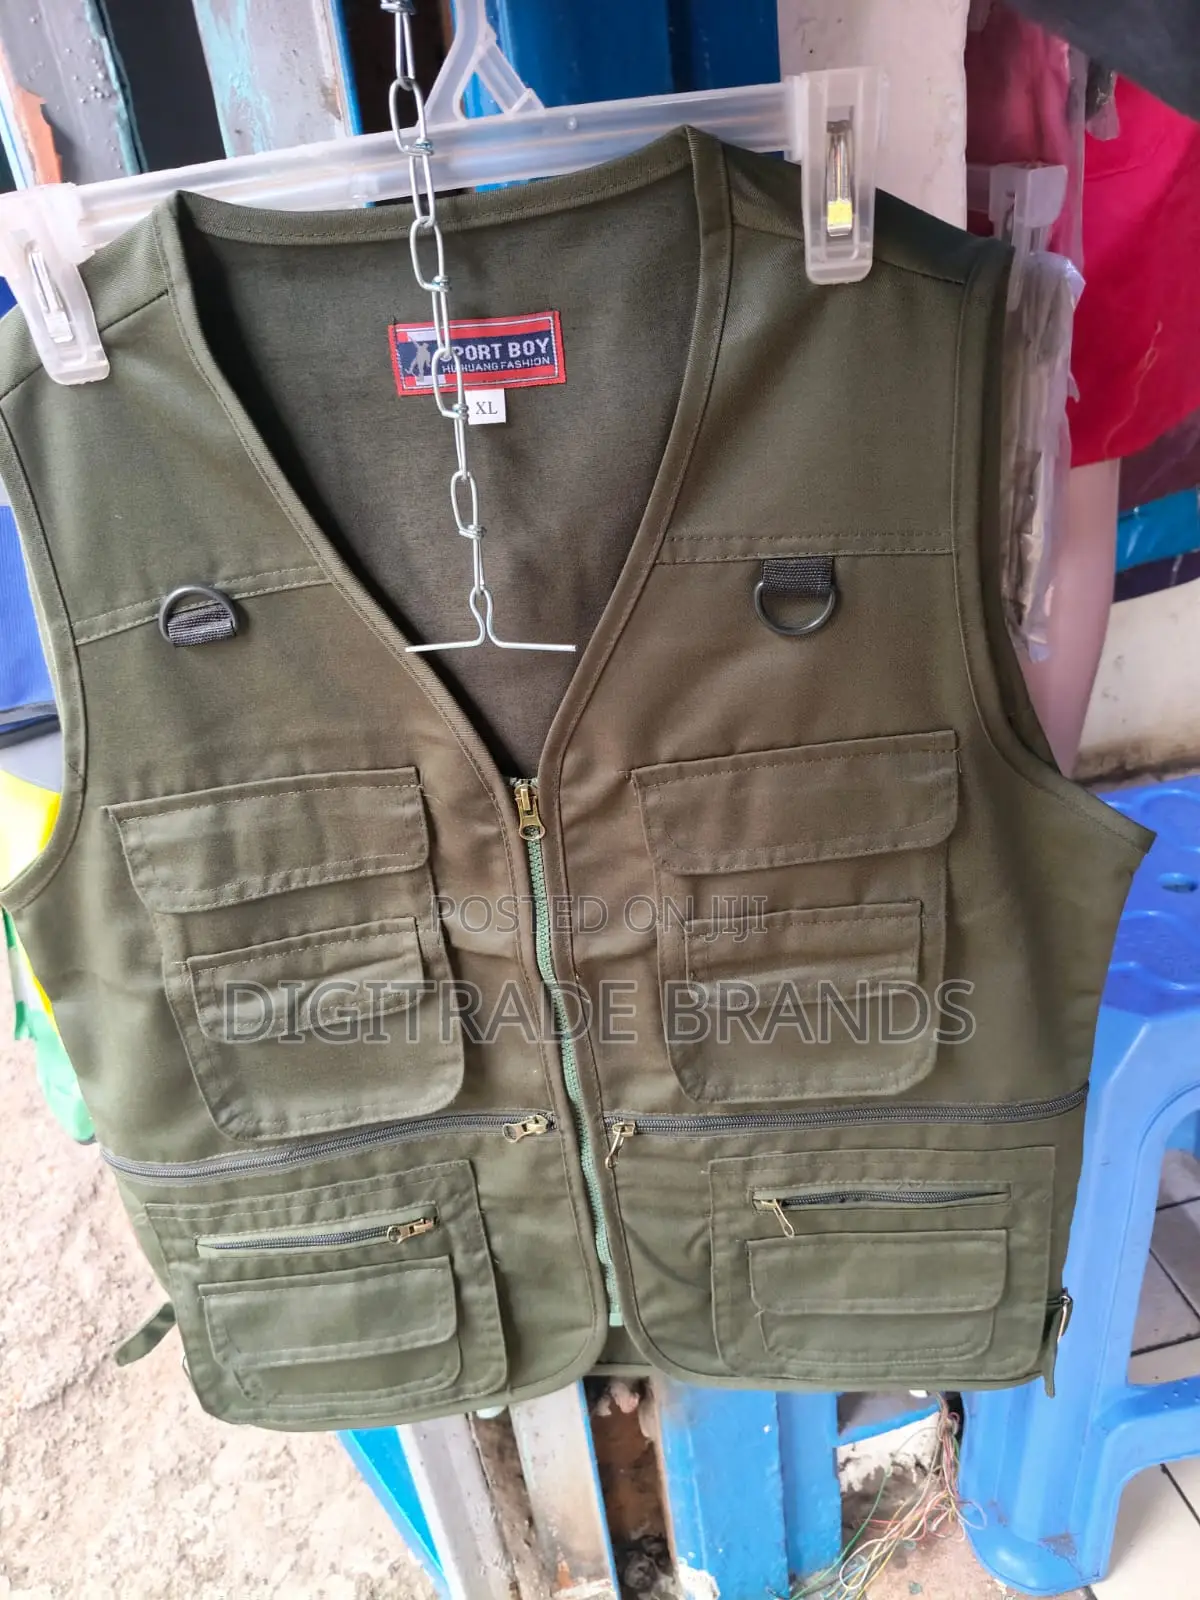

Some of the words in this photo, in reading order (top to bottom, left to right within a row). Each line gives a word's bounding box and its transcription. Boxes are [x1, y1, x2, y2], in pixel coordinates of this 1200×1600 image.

[440, 343, 502, 361] PORT
[507, 337, 549, 358] BOY
[501, 356, 550, 369] FASHION
[475, 401, 498, 414] XL
